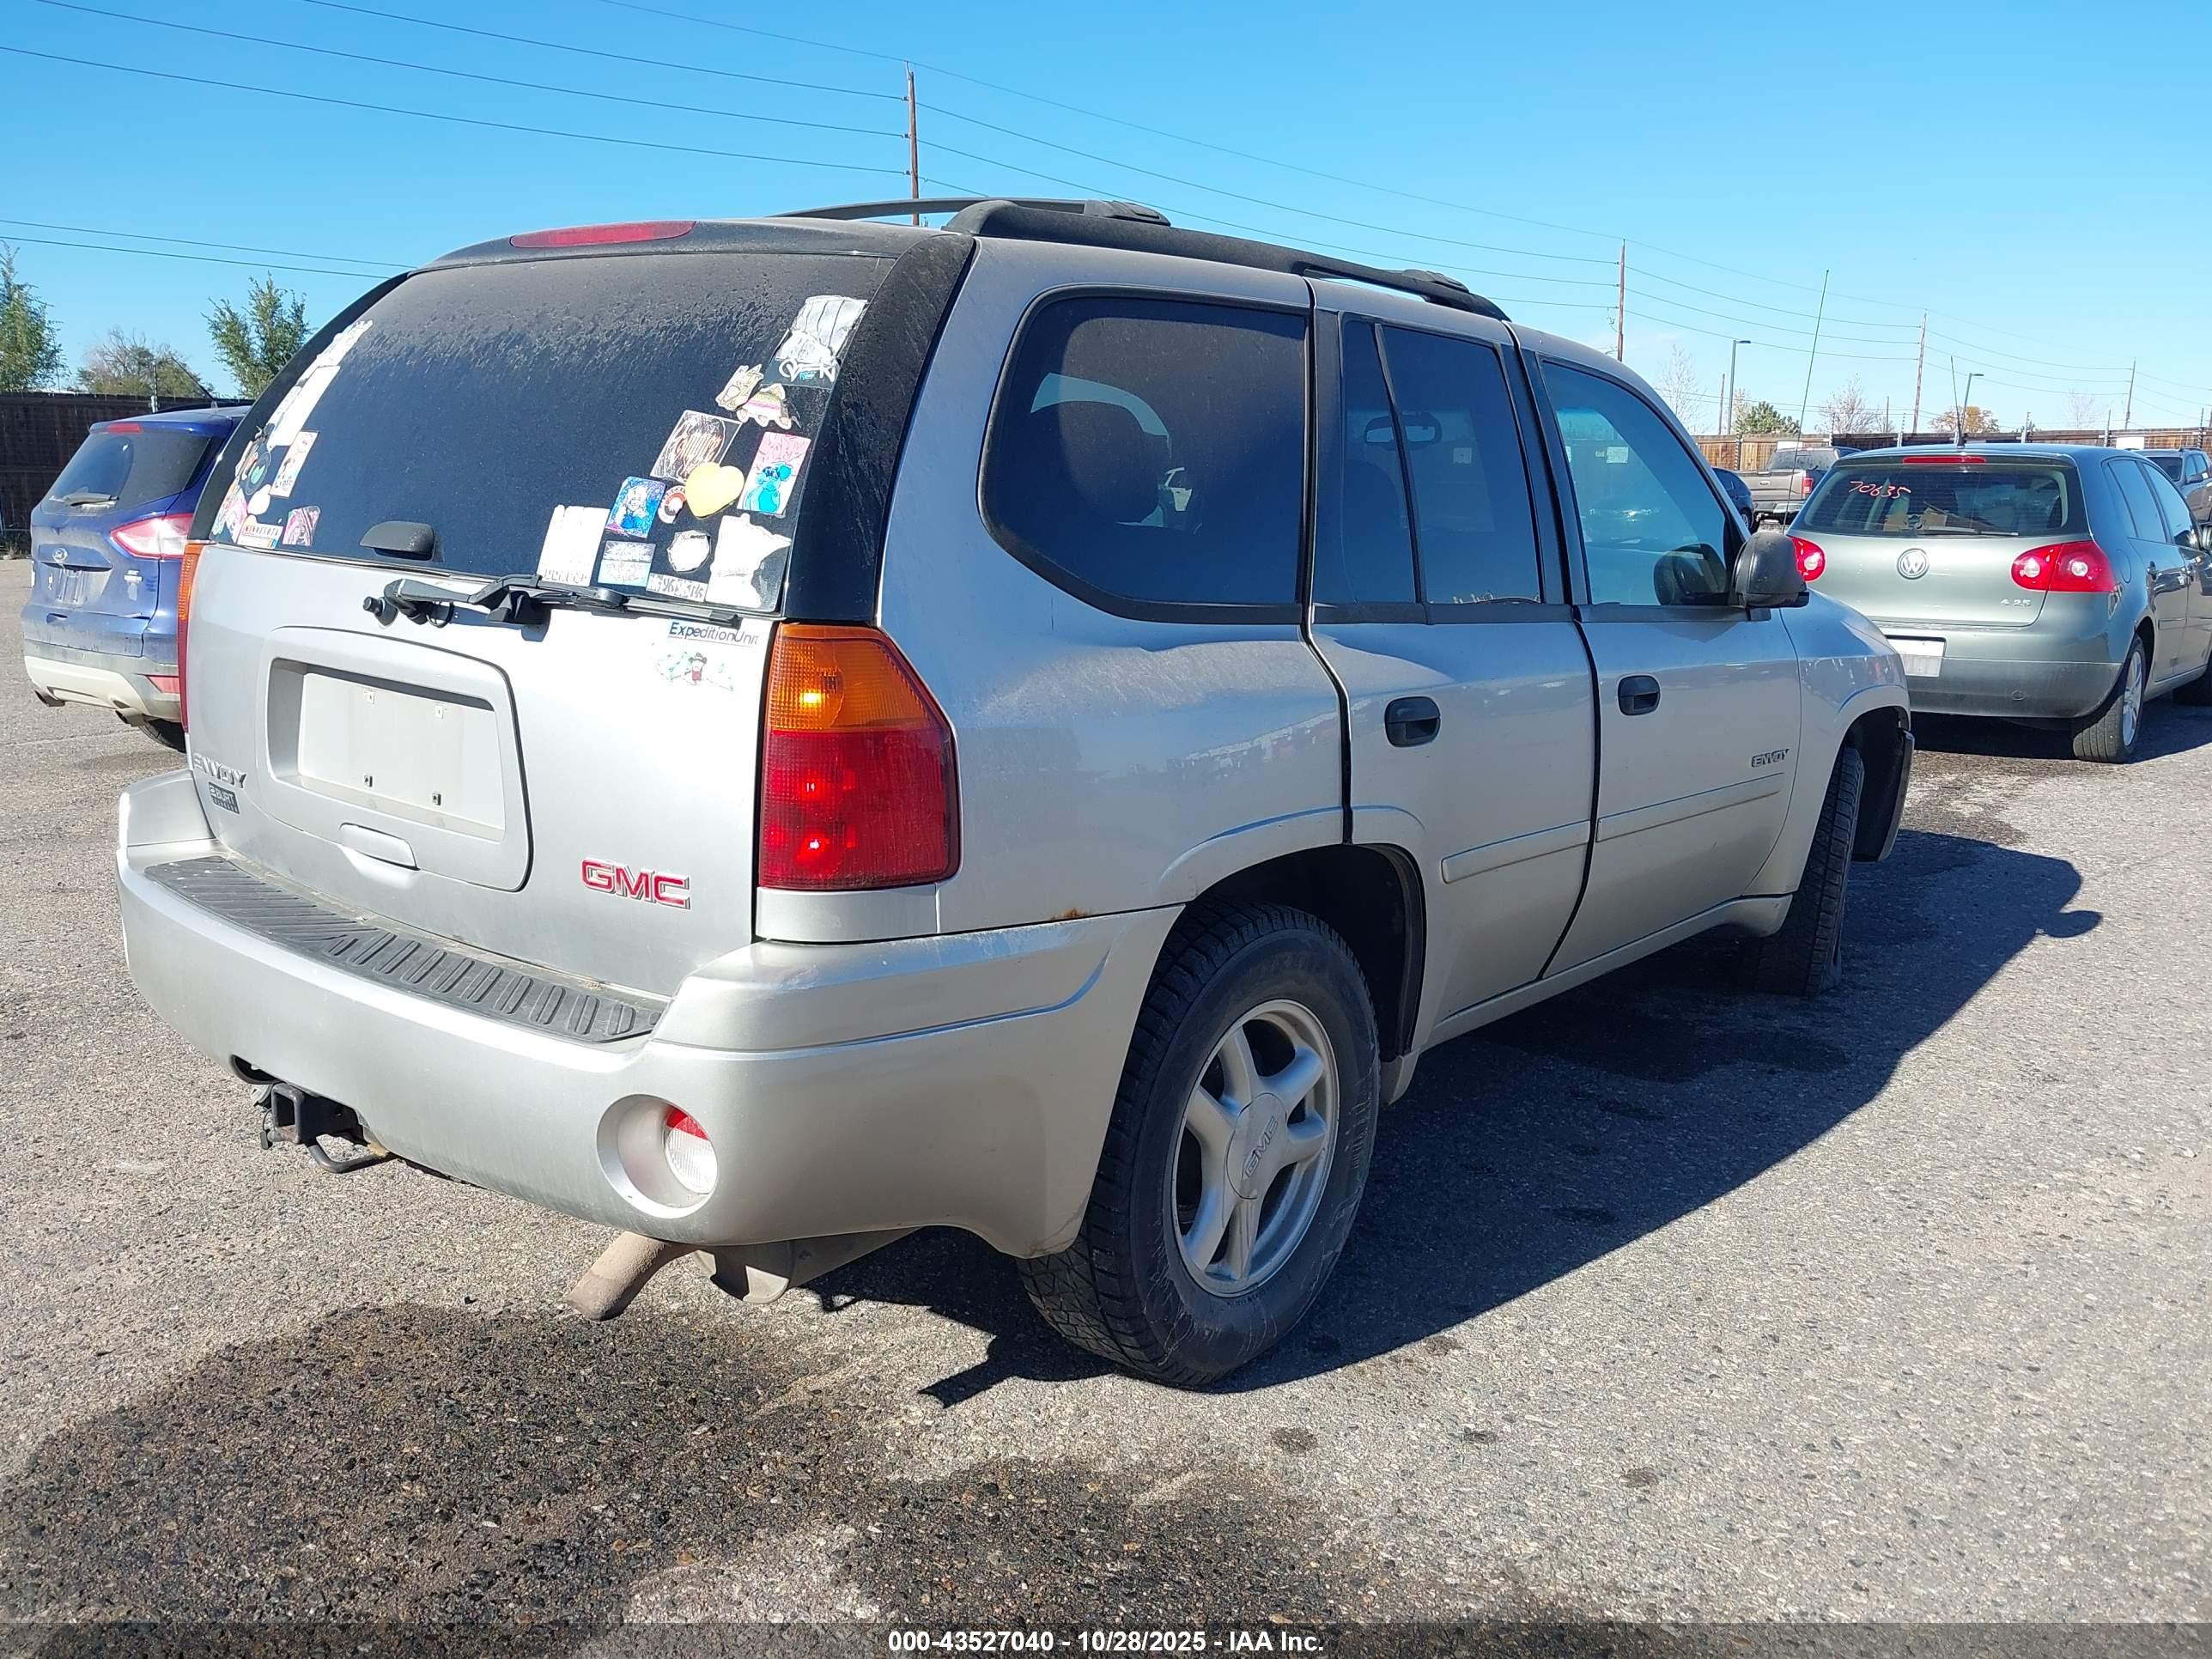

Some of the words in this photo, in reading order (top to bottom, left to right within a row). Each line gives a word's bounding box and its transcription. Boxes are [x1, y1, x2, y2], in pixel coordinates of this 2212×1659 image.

[1849, 481, 1911, 499] 70635
[193, 752, 247, 790] ENVOY
[1752, 748, 1790, 768] ENVOY
[581, 858, 691, 910] GMC
[1242, 1115, 1279, 1180] GMC
